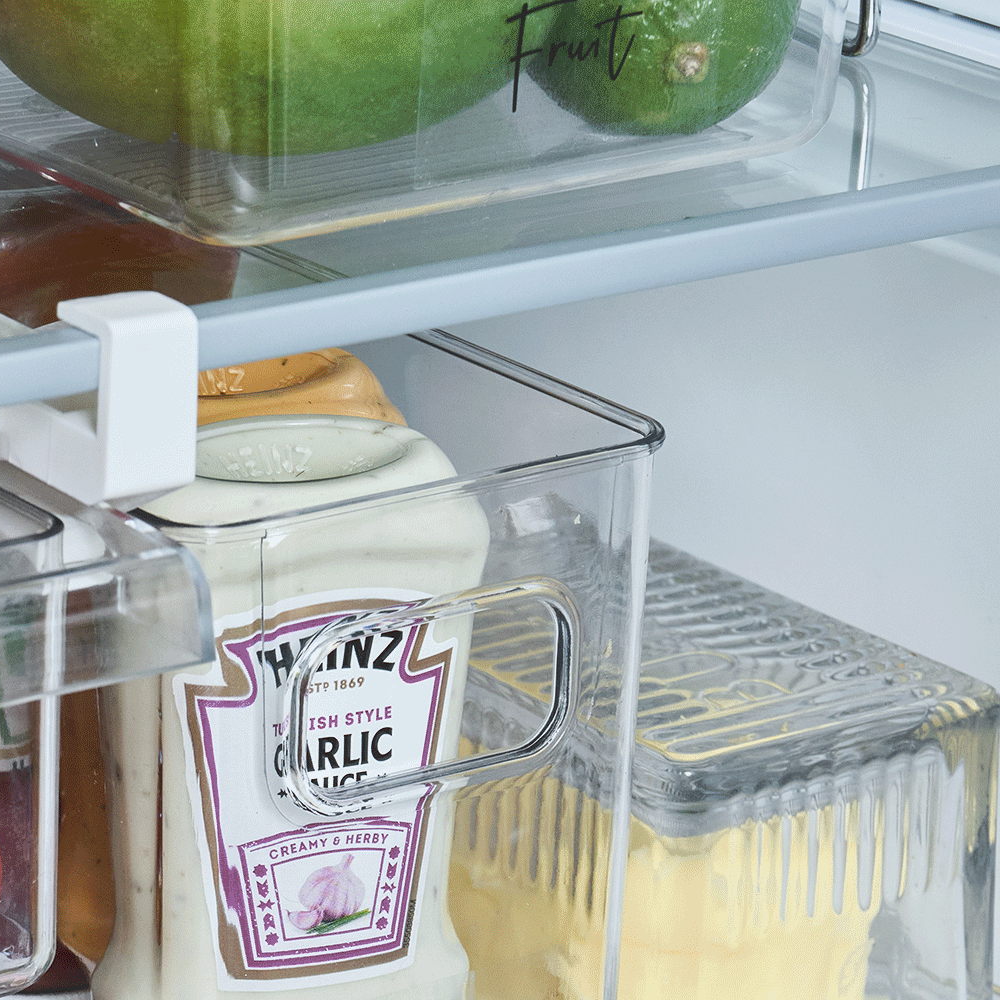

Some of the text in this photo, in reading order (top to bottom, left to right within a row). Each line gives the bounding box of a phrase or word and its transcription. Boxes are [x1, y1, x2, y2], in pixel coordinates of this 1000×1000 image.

[506, 0, 643, 112] Fruit
[333, 676, 366, 691] 1869
[344, 705, 393, 727] STYLE
[269, 833, 390, 860] CREAMY & HERBY
